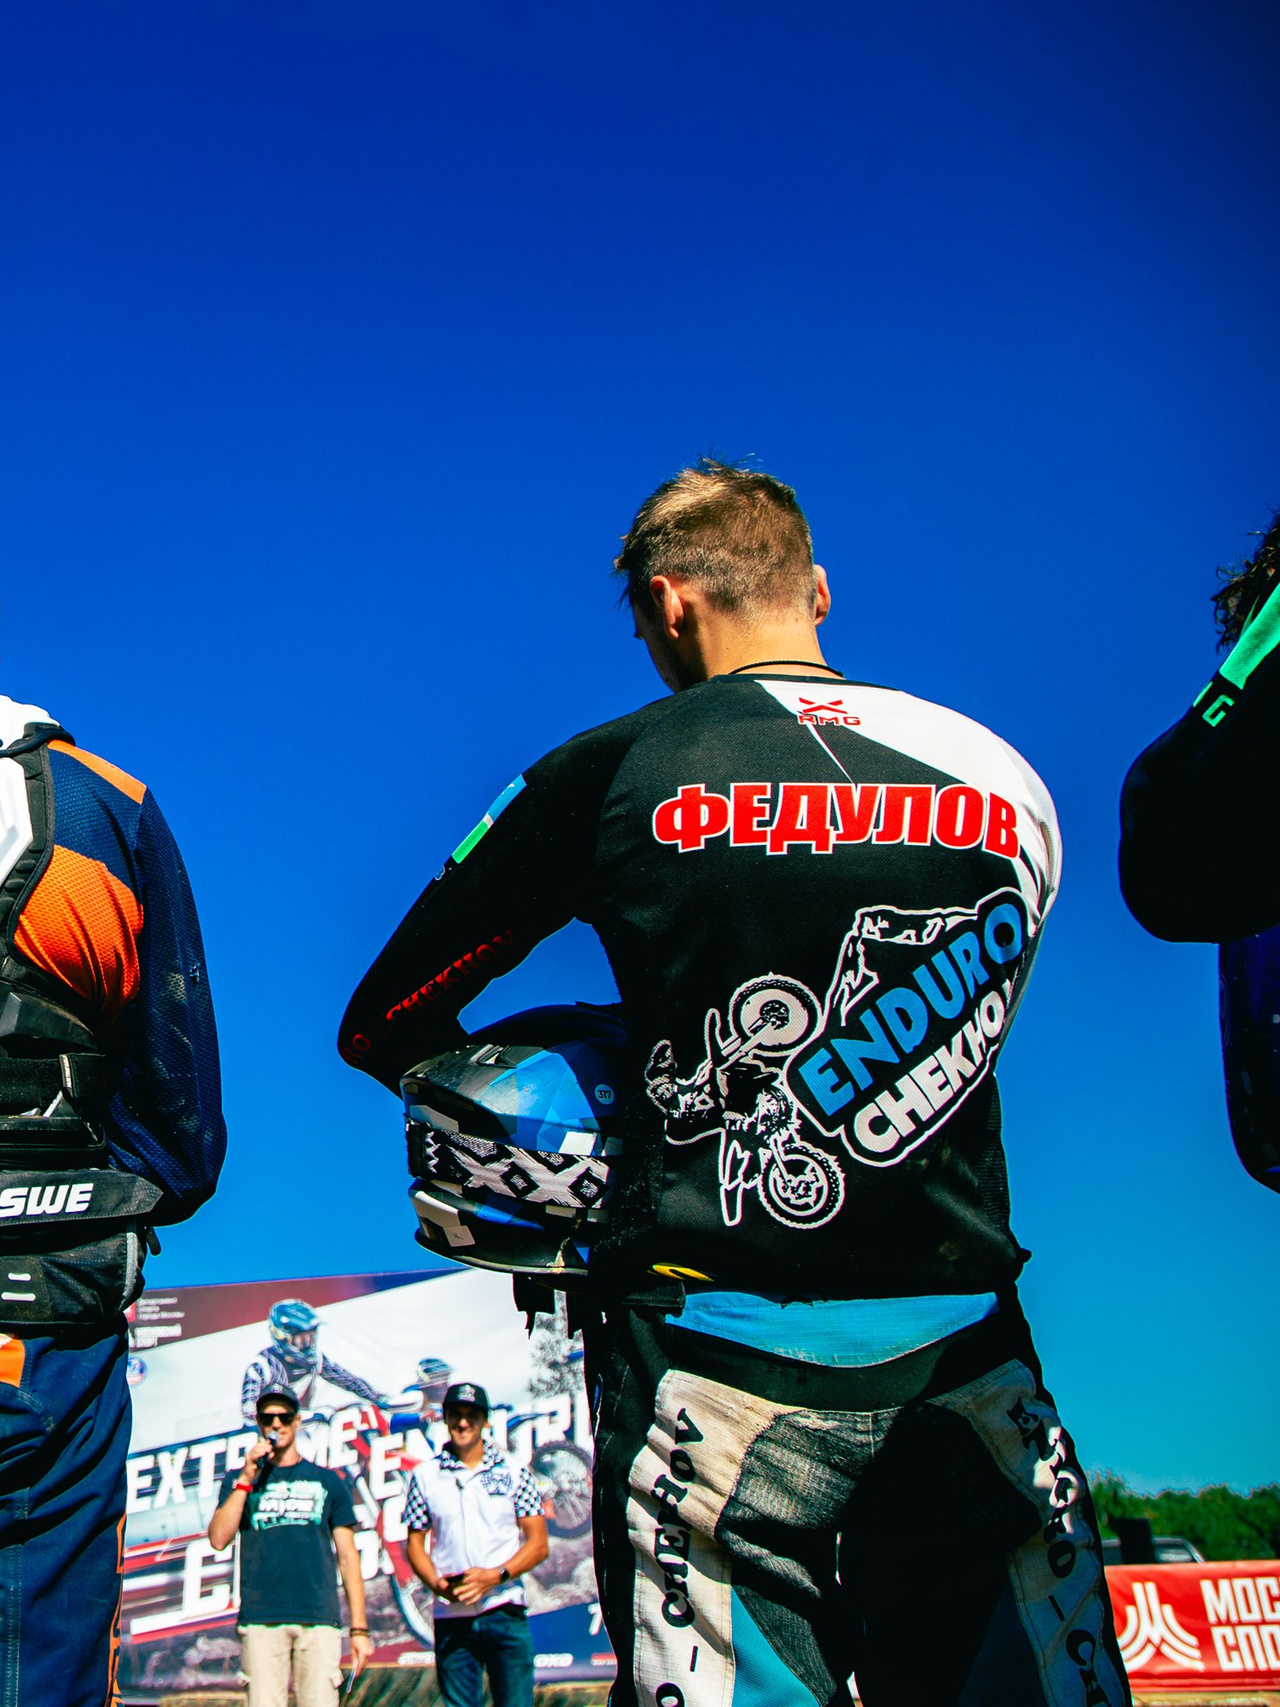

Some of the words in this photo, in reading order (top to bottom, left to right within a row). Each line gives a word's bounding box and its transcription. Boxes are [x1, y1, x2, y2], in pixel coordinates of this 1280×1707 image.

[797, 715, 861, 726] RMG
[652, 782, 1021, 859] ФЕДУЛОВ
[798, 903, 1023, 1116] ENDURO
[1199, 1576, 1280, 1625] МОС
